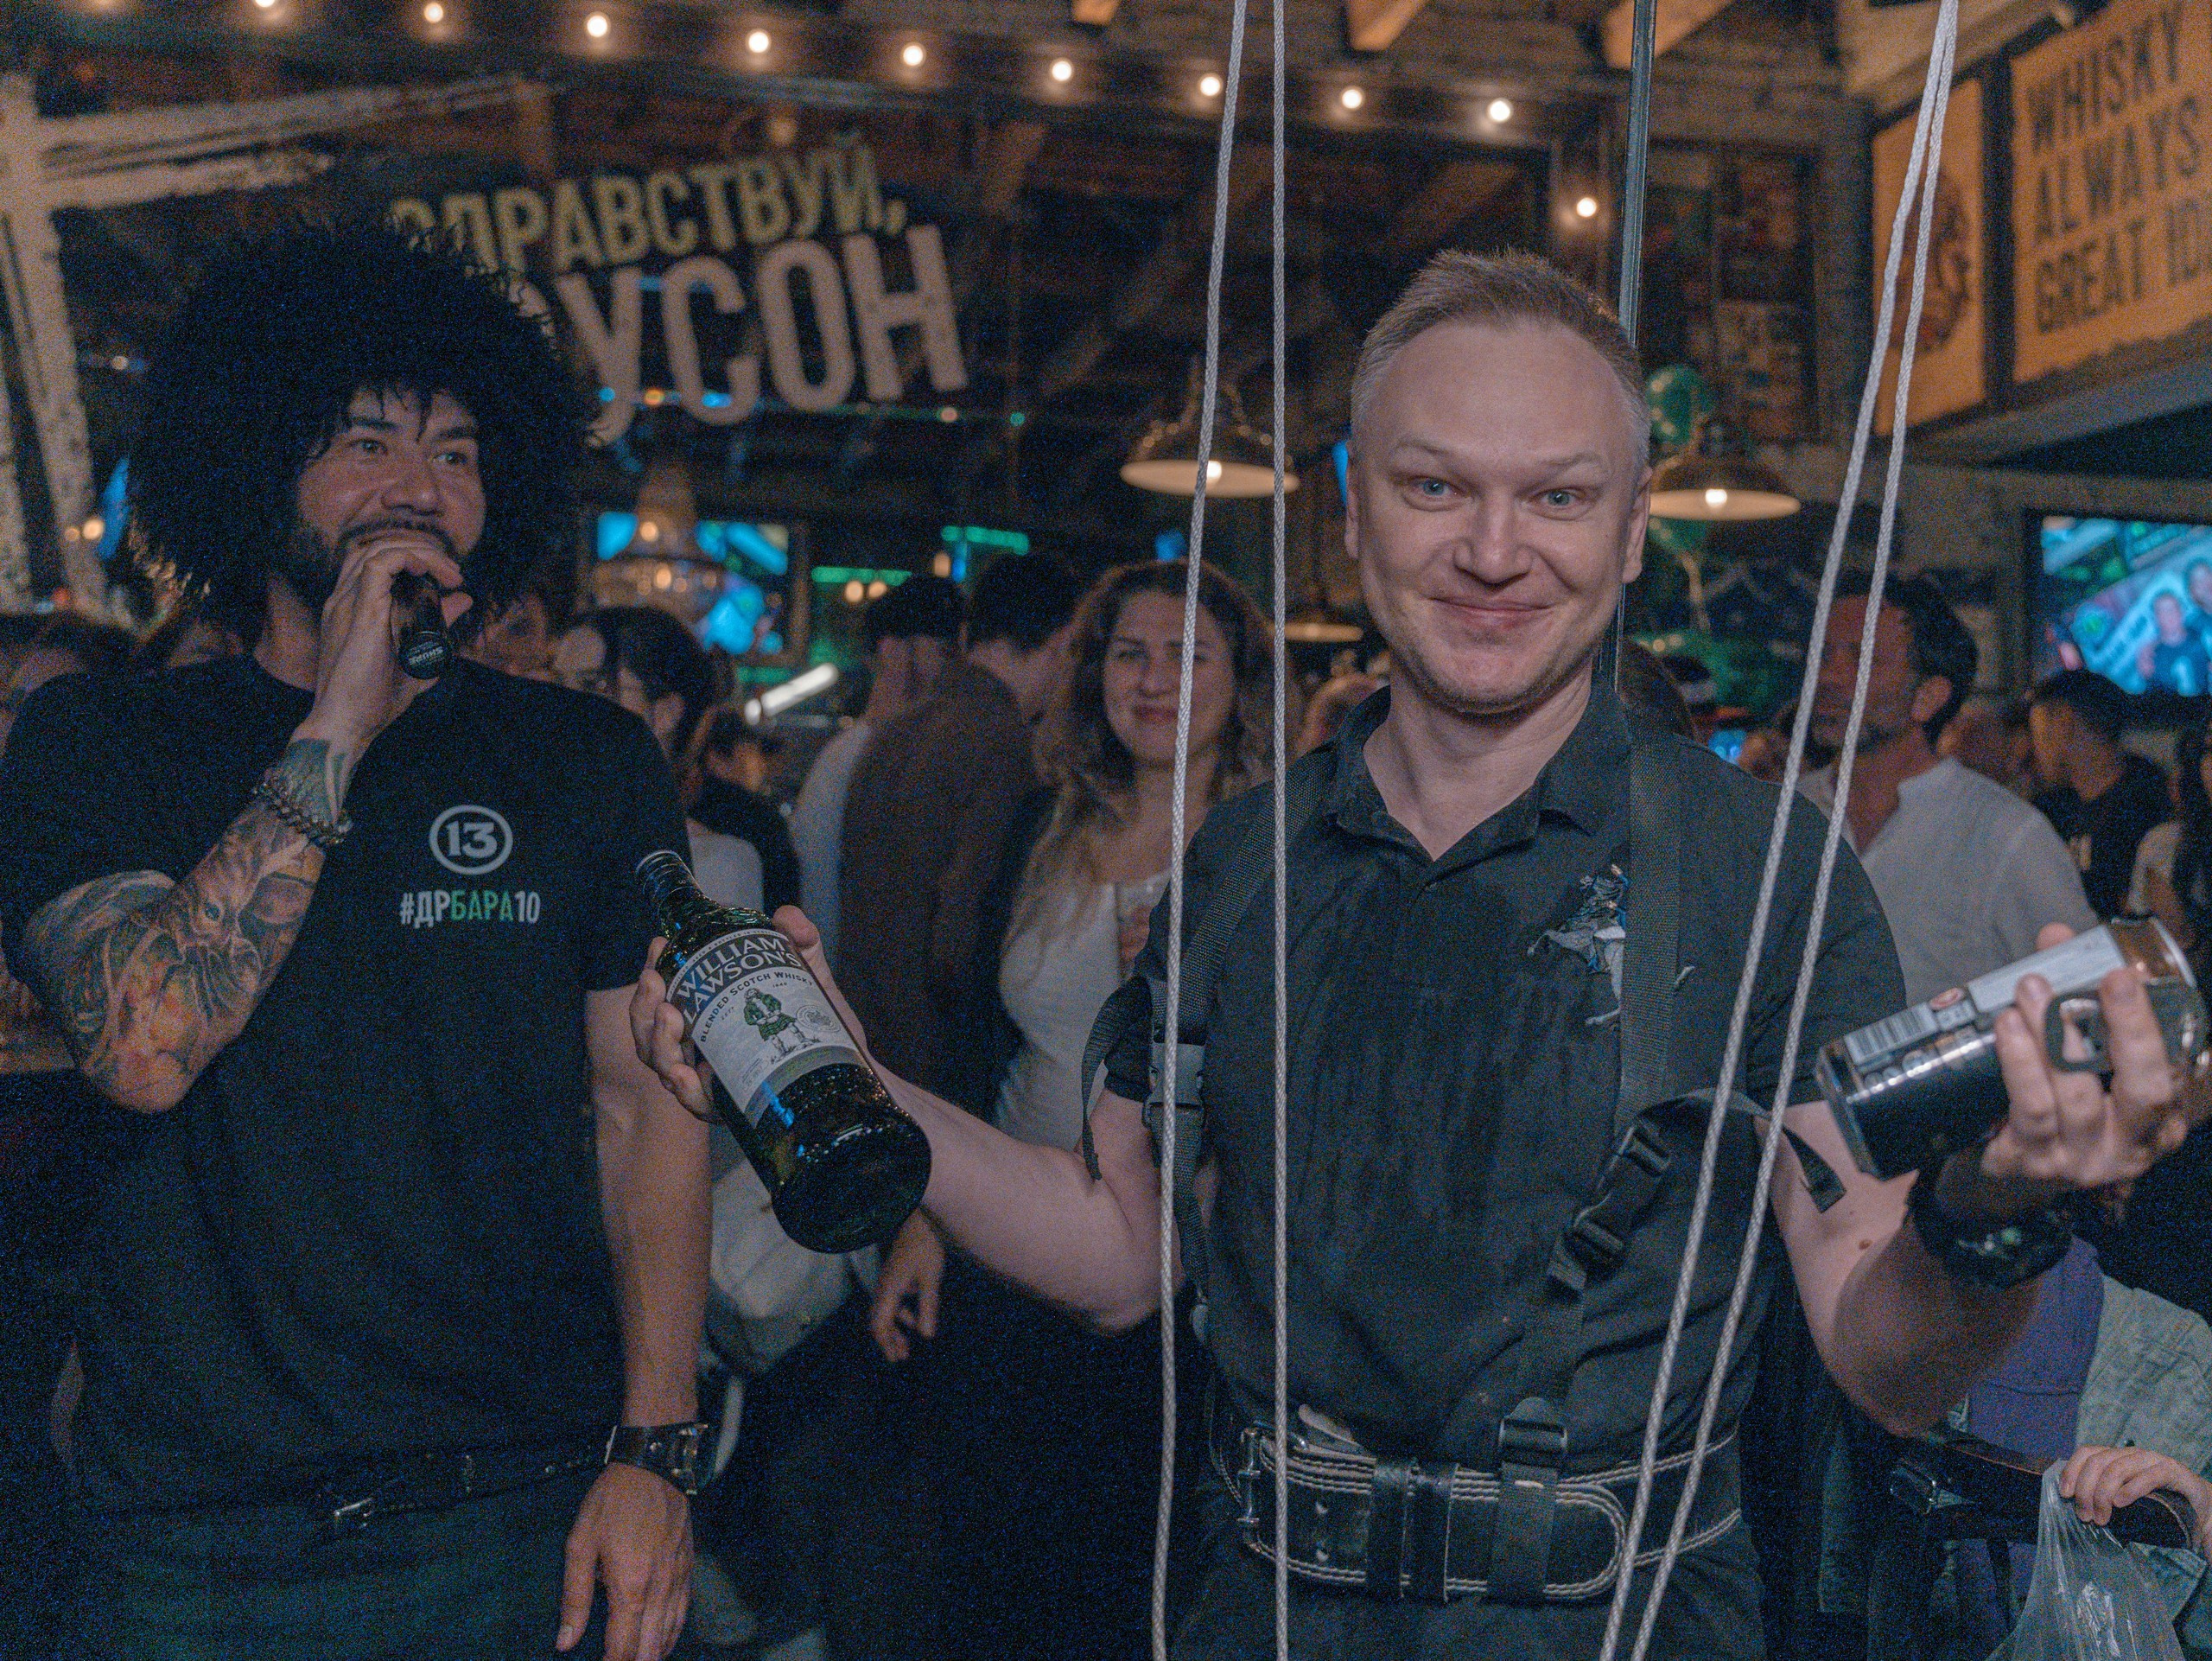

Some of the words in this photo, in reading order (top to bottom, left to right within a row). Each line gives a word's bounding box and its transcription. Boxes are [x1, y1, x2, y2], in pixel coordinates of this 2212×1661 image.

[2028, 2, 2183, 152] WHISKY
[2036, 94, 2202, 242] ALWAYS
[2037, 217, 2146, 334] GREAT
[2166, 197, 2212, 288] ID
[508, 223, 969, 448] УСОН
[444, 820, 499, 859] 13
[399, 889, 542, 929] #ДРБАРА10
[678, 937, 785, 999] WILLIAM
[683, 951, 802, 1024] LAWSON'S
[700, 996, 729, 1043] BLENDED
[730, 972, 772, 996] SCOTCH
